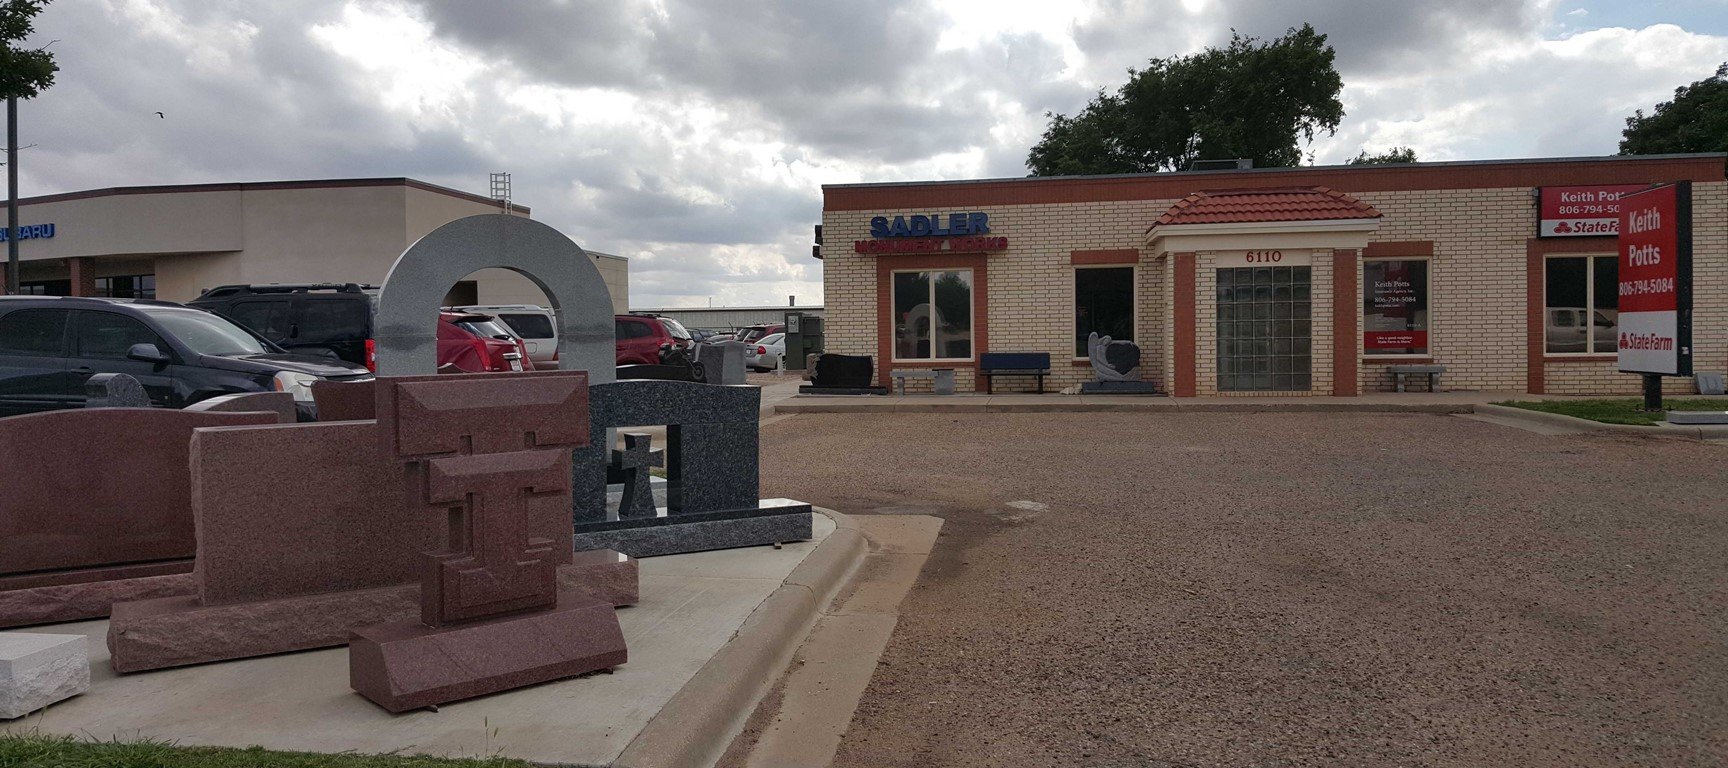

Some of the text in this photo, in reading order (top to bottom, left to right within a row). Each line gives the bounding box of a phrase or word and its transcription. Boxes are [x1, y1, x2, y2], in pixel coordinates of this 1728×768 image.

[1561, 191, 1625, 202] Keith Pot
[1559, 205, 1619, 214] 806-794-50
[870, 212, 990, 237] SADLER
[1573, 221, 1619, 233] StateFa
[1629, 206, 1661, 234] Keith
[855, 237, 1008, 254] MONUMENT WORKS
[1246, 250, 1282, 263] 6110
[1629, 243, 1661, 268] Potts
[1619, 277, 1674, 296] 806-794-5084
